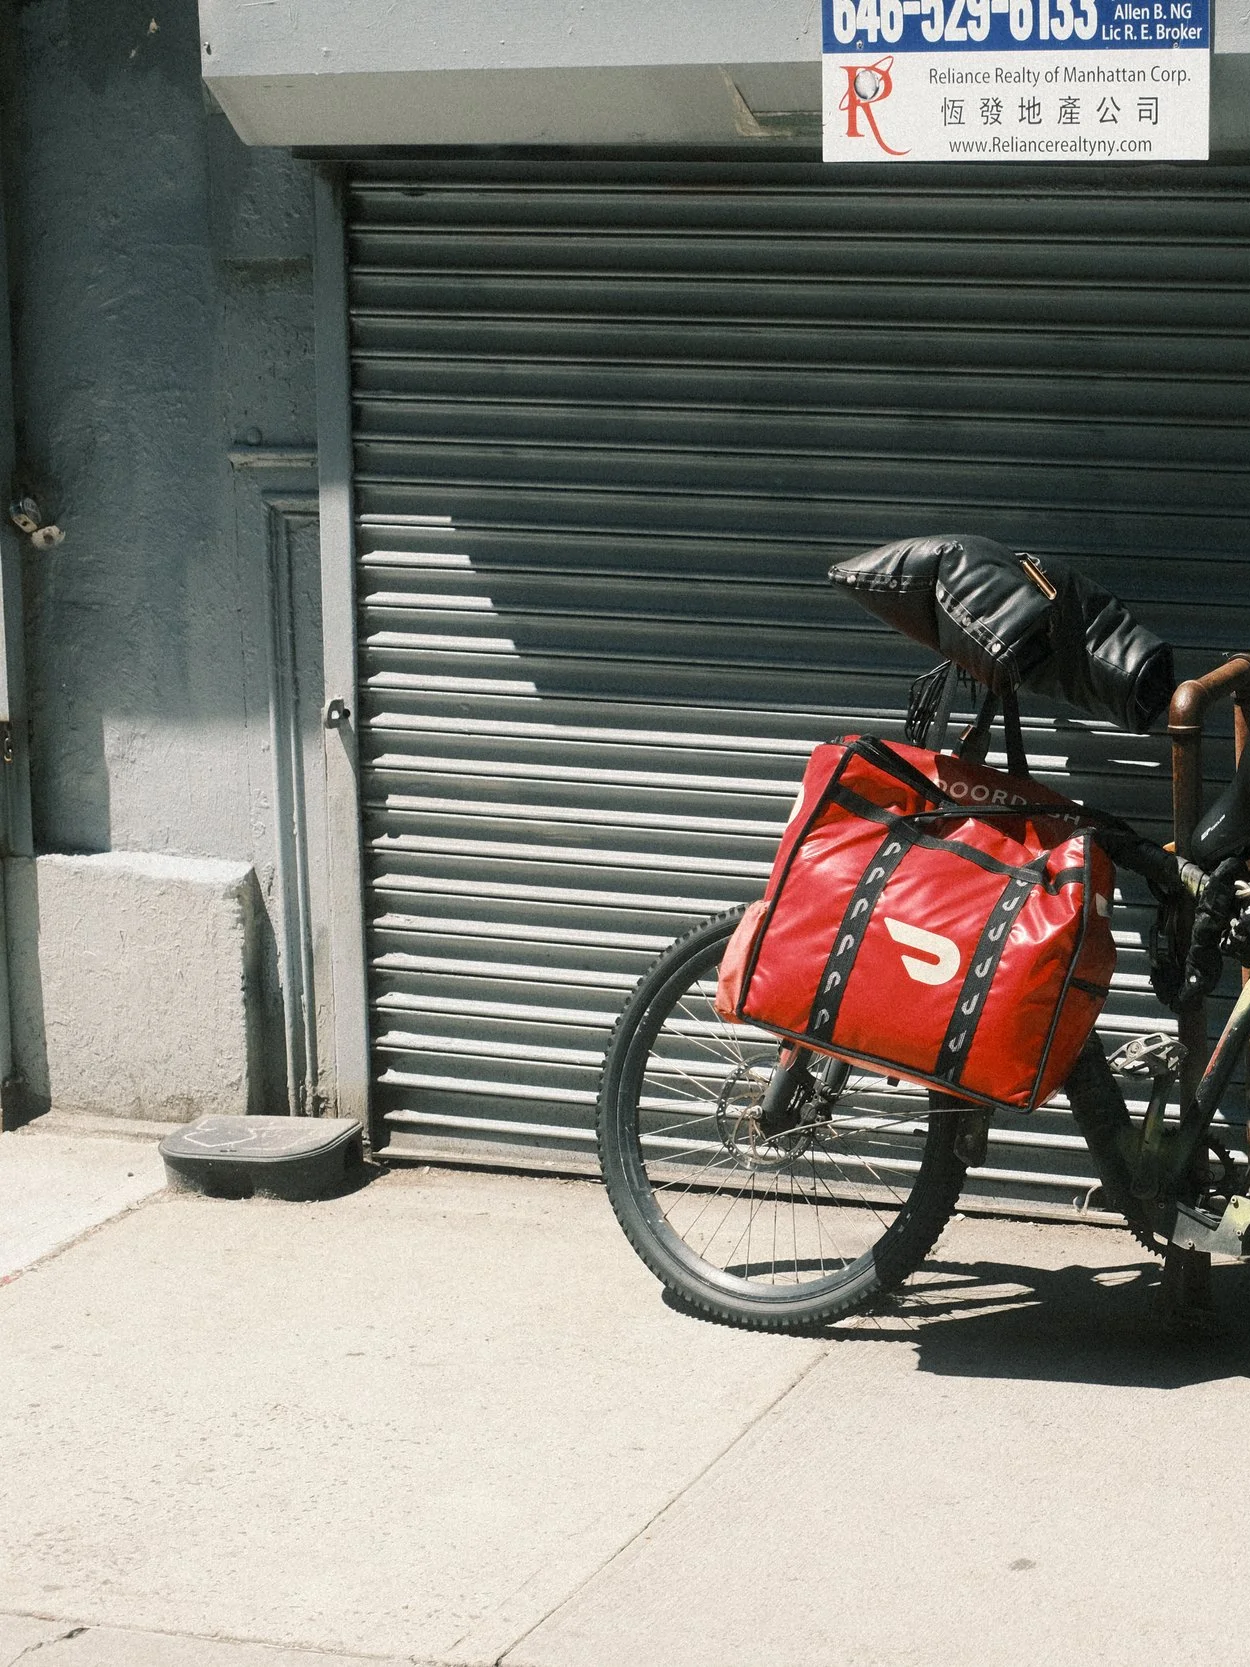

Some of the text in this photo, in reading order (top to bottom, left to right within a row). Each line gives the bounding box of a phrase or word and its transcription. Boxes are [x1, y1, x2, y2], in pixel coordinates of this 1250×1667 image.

[835, 0, 1098, 43] 646-529-6133
[1114, 3, 1192, 20] Allen B. NG
[1102, 23, 1202, 40] Lic R. E. Broker
[929, 65, 1191, 87] Reliance Realty of Manhattan Corp.
[949, 136, 1152, 156] www.Reliancerealtyny.com
[938, 779, 1081, 825] DOORDH
